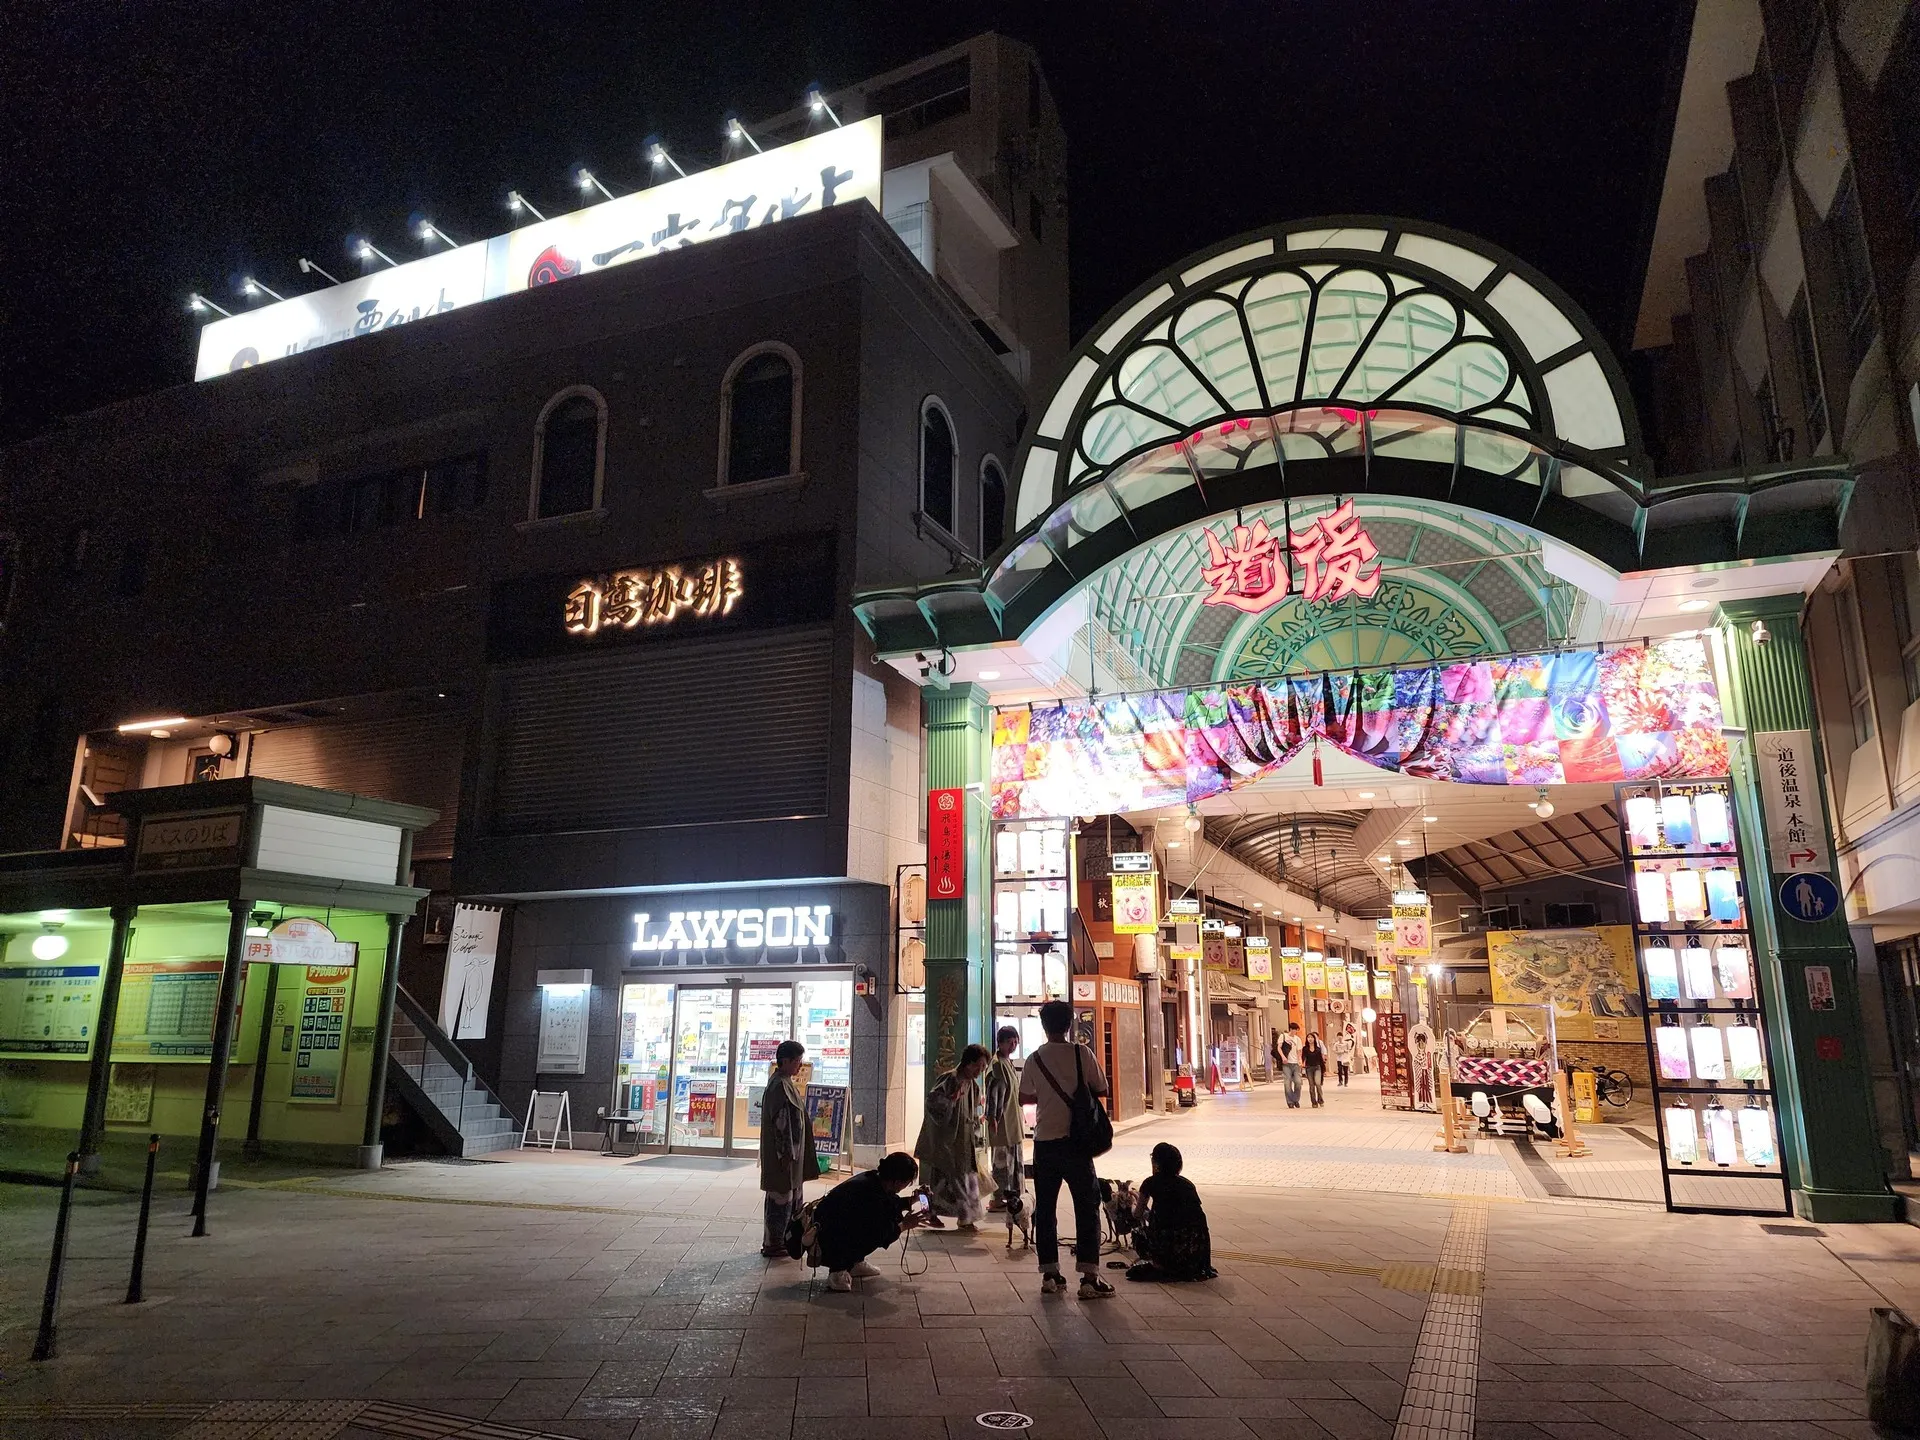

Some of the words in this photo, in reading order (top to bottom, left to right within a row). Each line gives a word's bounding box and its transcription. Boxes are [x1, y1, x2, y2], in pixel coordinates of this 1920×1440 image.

[1201, 497, 1382, 614] 道後
[151, 822, 230, 846] バスのりば
[941, 813, 951, 873] 飛鳥乃湯泉
[632, 905, 832, 951] LAWSON
[828, 1019, 846, 1027] ATM
[1379, 1017, 1391, 1076] 飛鳥乃湯泉
[808, 1087, 845, 1099] ローソン。
